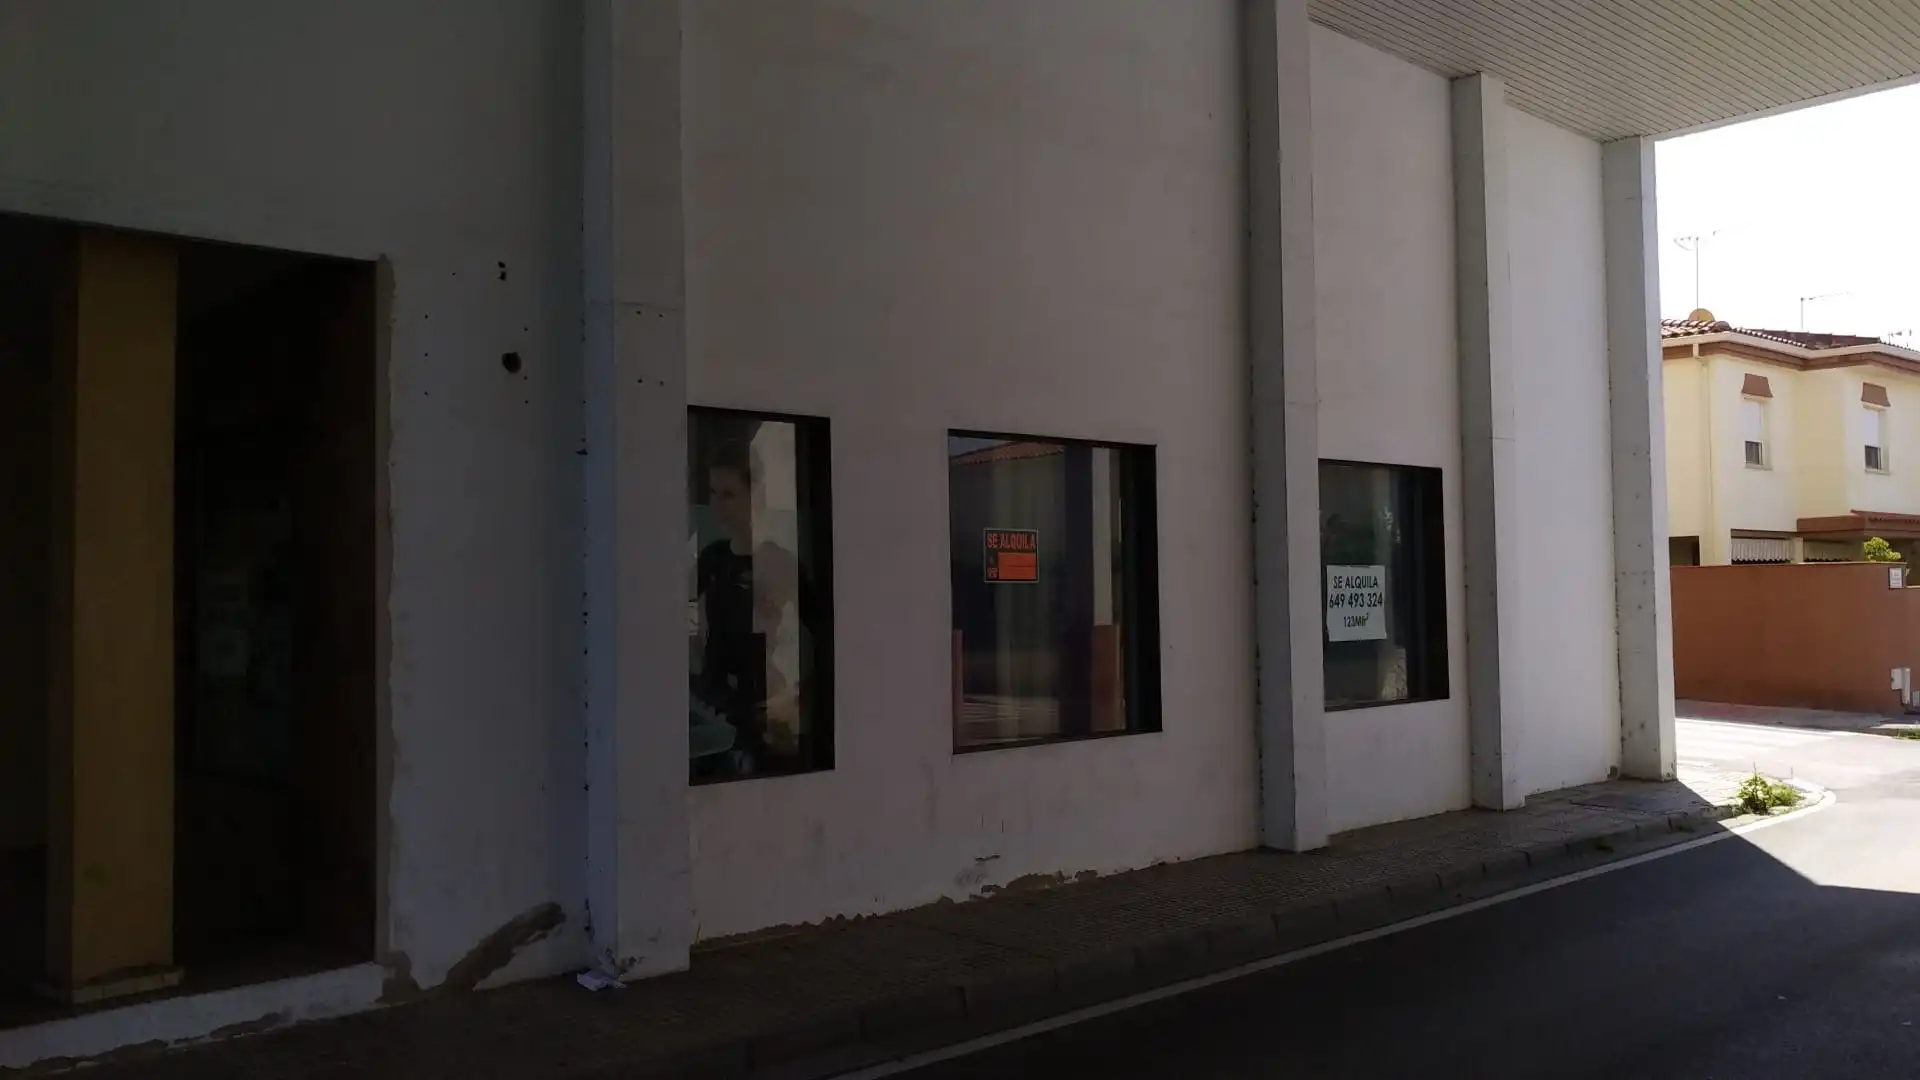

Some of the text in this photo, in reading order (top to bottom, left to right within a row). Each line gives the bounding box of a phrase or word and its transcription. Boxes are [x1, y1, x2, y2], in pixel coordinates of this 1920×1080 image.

[986, 531, 1036, 549] SE ALQUILA
[1333, 575, 1379, 589] SE ALQUILA
[1329, 592, 1383, 609] 649 493 324
